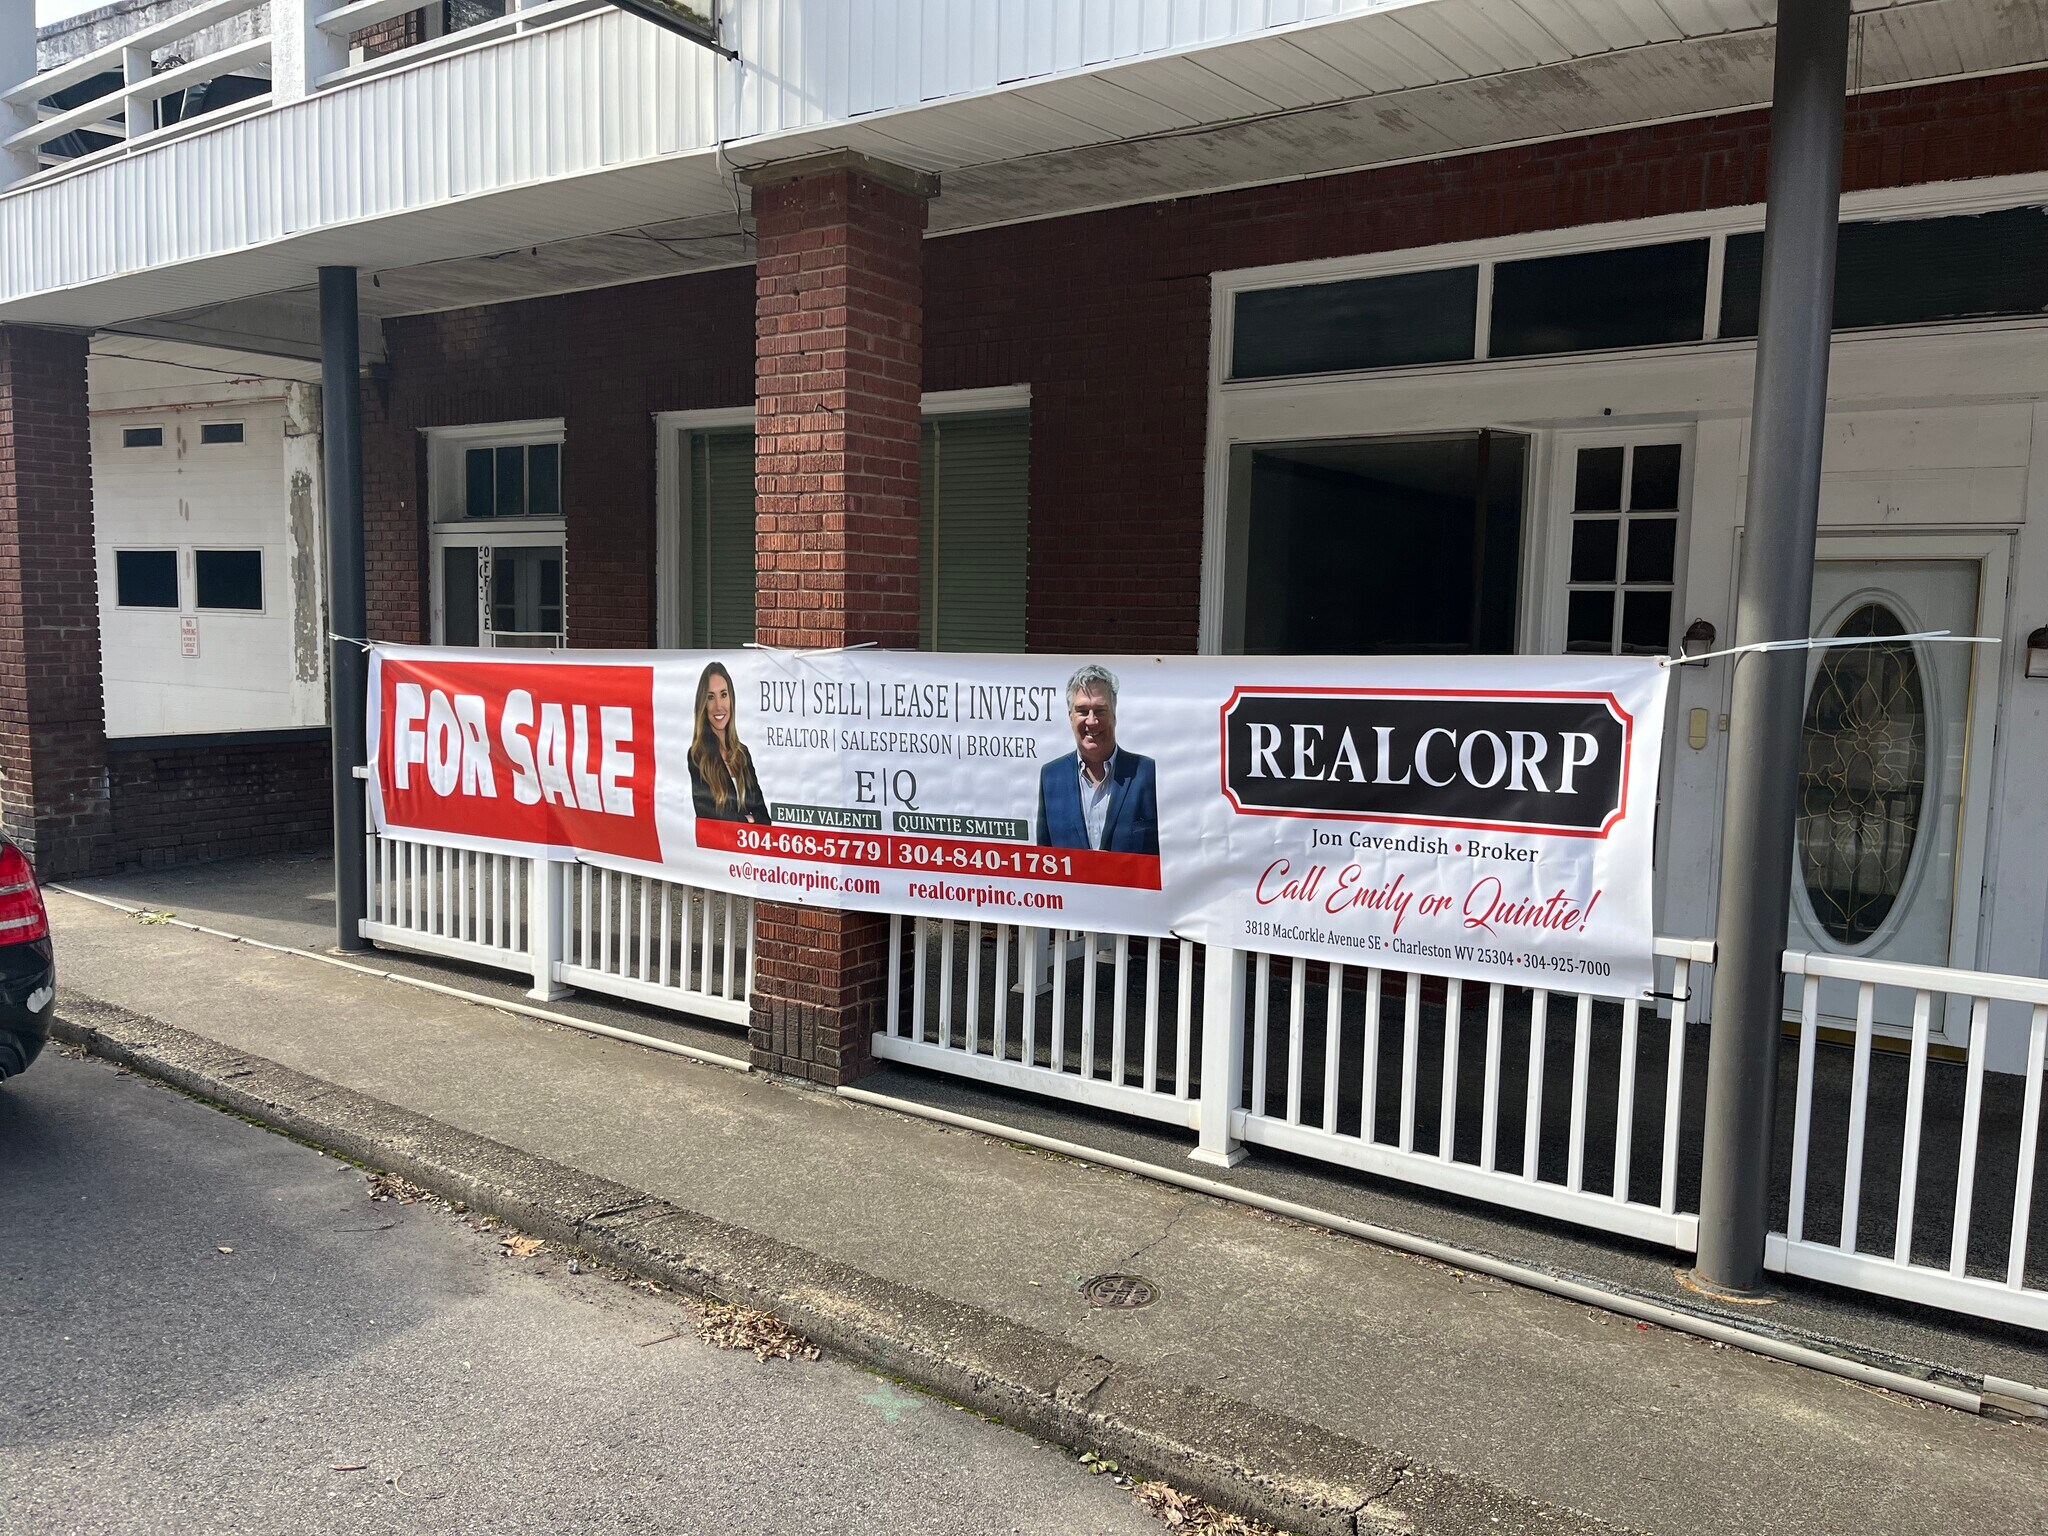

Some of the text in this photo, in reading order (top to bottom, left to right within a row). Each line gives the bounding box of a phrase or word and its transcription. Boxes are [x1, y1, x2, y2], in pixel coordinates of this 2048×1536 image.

[483, 546, 491, 630] OFFICE
[969, 686, 1056, 721] INVEST
[394, 682, 635, 817] FOR SALE
[767, 727, 1038, 758] REALTOR SALESPERSON BROKER
[1245, 722, 1599, 794] REALCORP
[777, 807, 877, 828] EMILY VALENTI
[898, 815, 1016, 837] QUINTIE SMITH
[737, 829, 1072, 876] 304-668-5779 304-840-1781
[1312, 829, 1538, 862] Jon Cavendish Broker
[729, 862, 880, 894] ev@realcorpinc.com
[909, 881, 1063, 910] realcorpinc.com
[1256, 858, 1602, 938] Call Emily or Quintie!
[1245, 920, 1611, 976] 3818 MacCorkle Avenue SE Charleston WV 25304 304-925-7000
